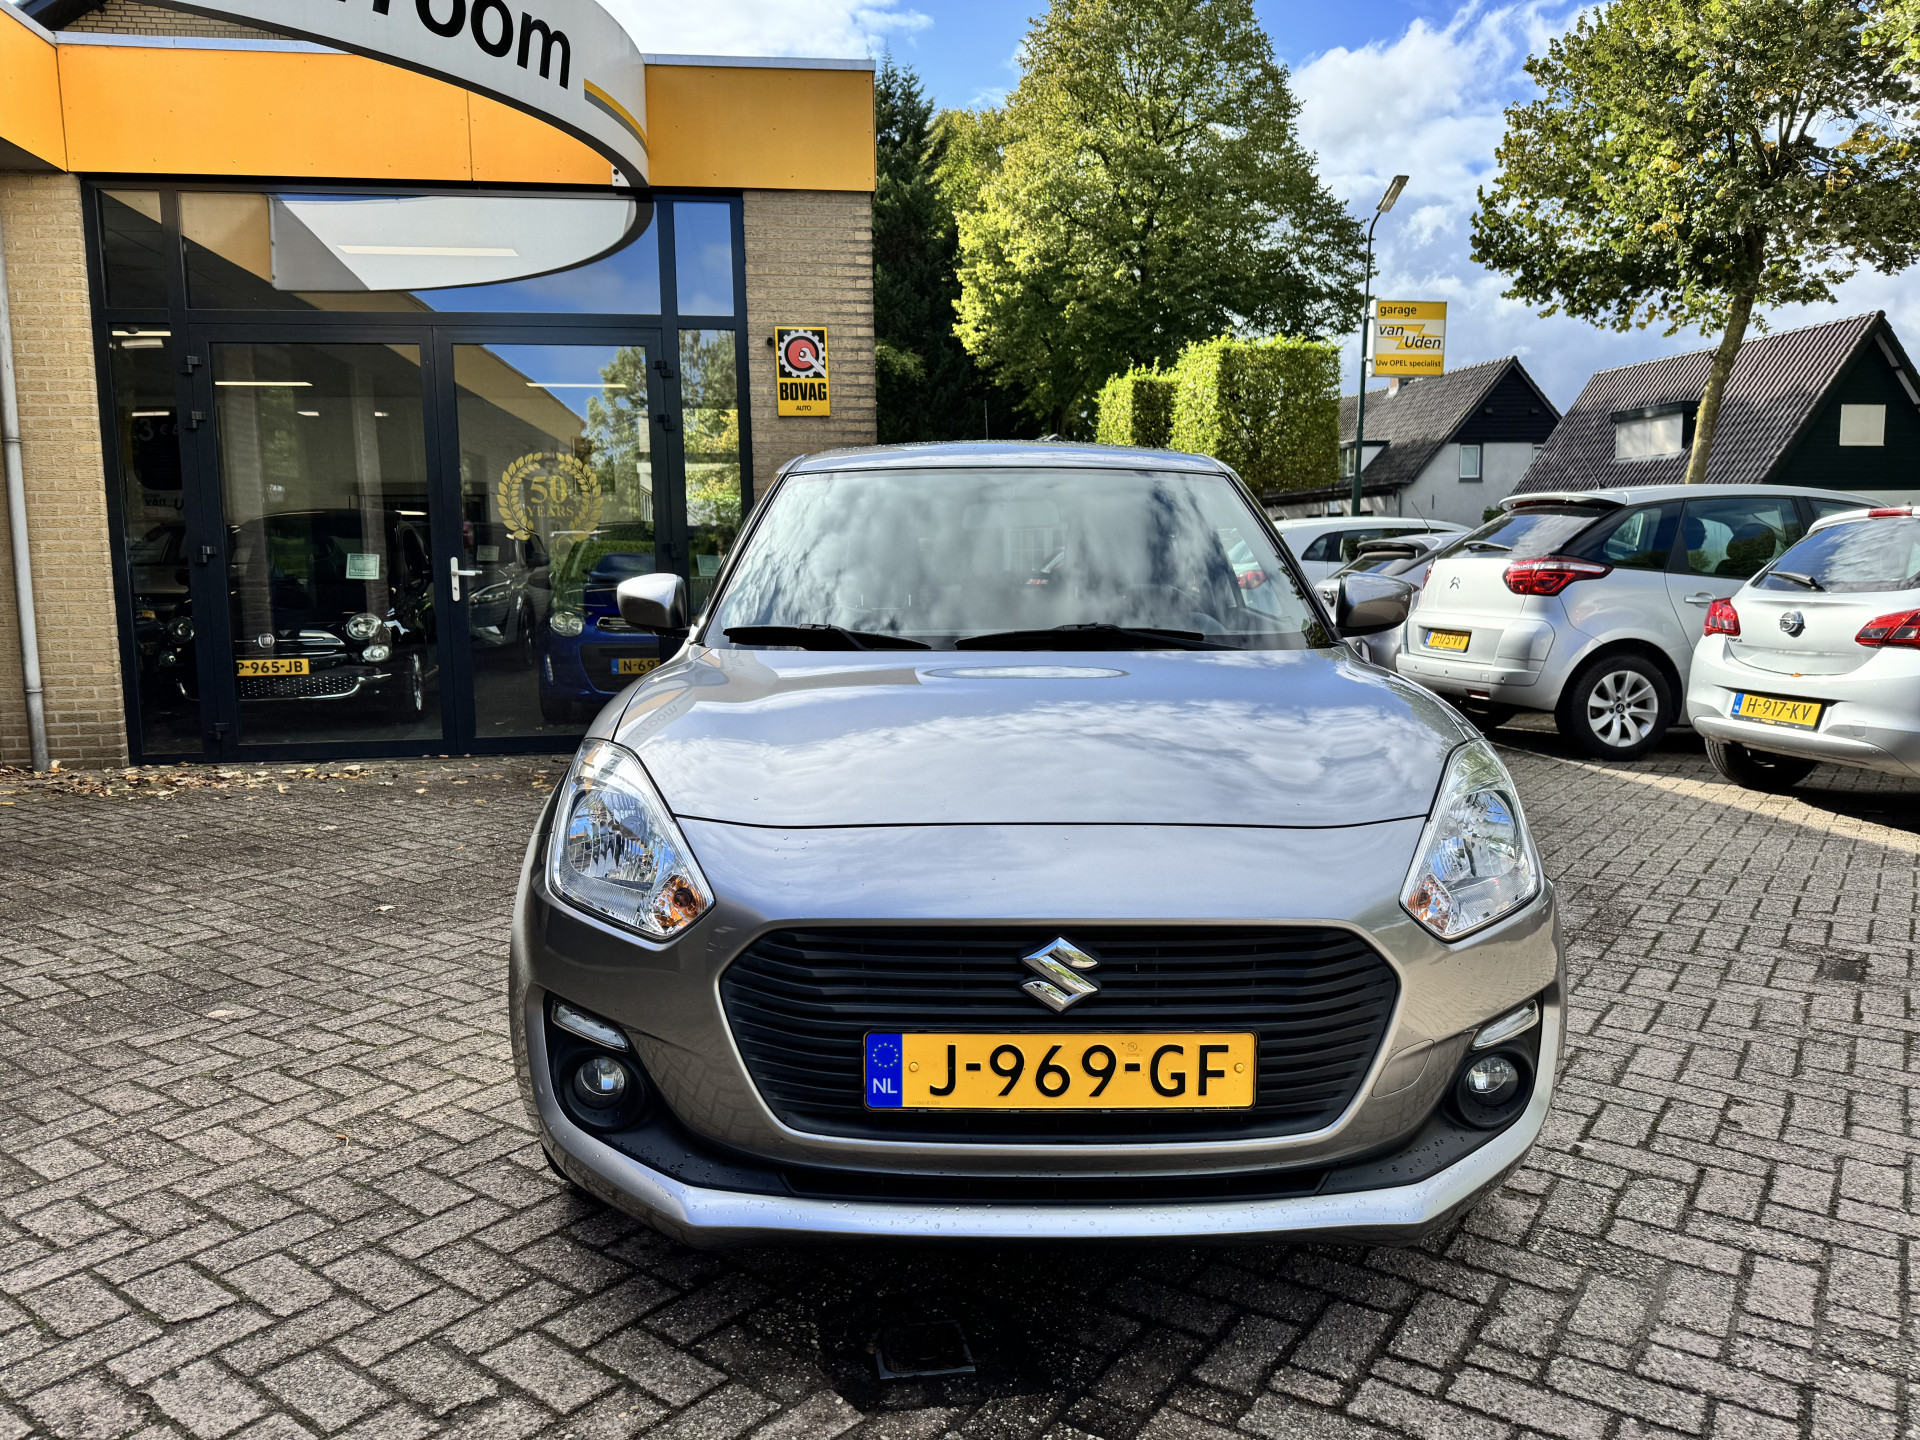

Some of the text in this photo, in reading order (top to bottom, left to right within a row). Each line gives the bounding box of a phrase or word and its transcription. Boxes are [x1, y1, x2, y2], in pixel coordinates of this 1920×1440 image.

[372, 0, 570, 90] oom
[1380, 306, 1417, 317] garage
[1379, 326, 1404, 336] van
[1404, 335, 1442, 349] Uden
[1409, 359, 1441, 368] specialist
[779, 382, 827, 401] BOVAG
[530, 475, 568, 504] 50
[526, 505, 574, 517] YEARS
[237, 660, 303, 674] P-965-JB
[623, 659, 661, 672] N-69
[1746, 697, 1812, 720] H-917-KV
[929, 1044, 1229, 1097] J-969-GF
[873, 1078, 898, 1094] NL
